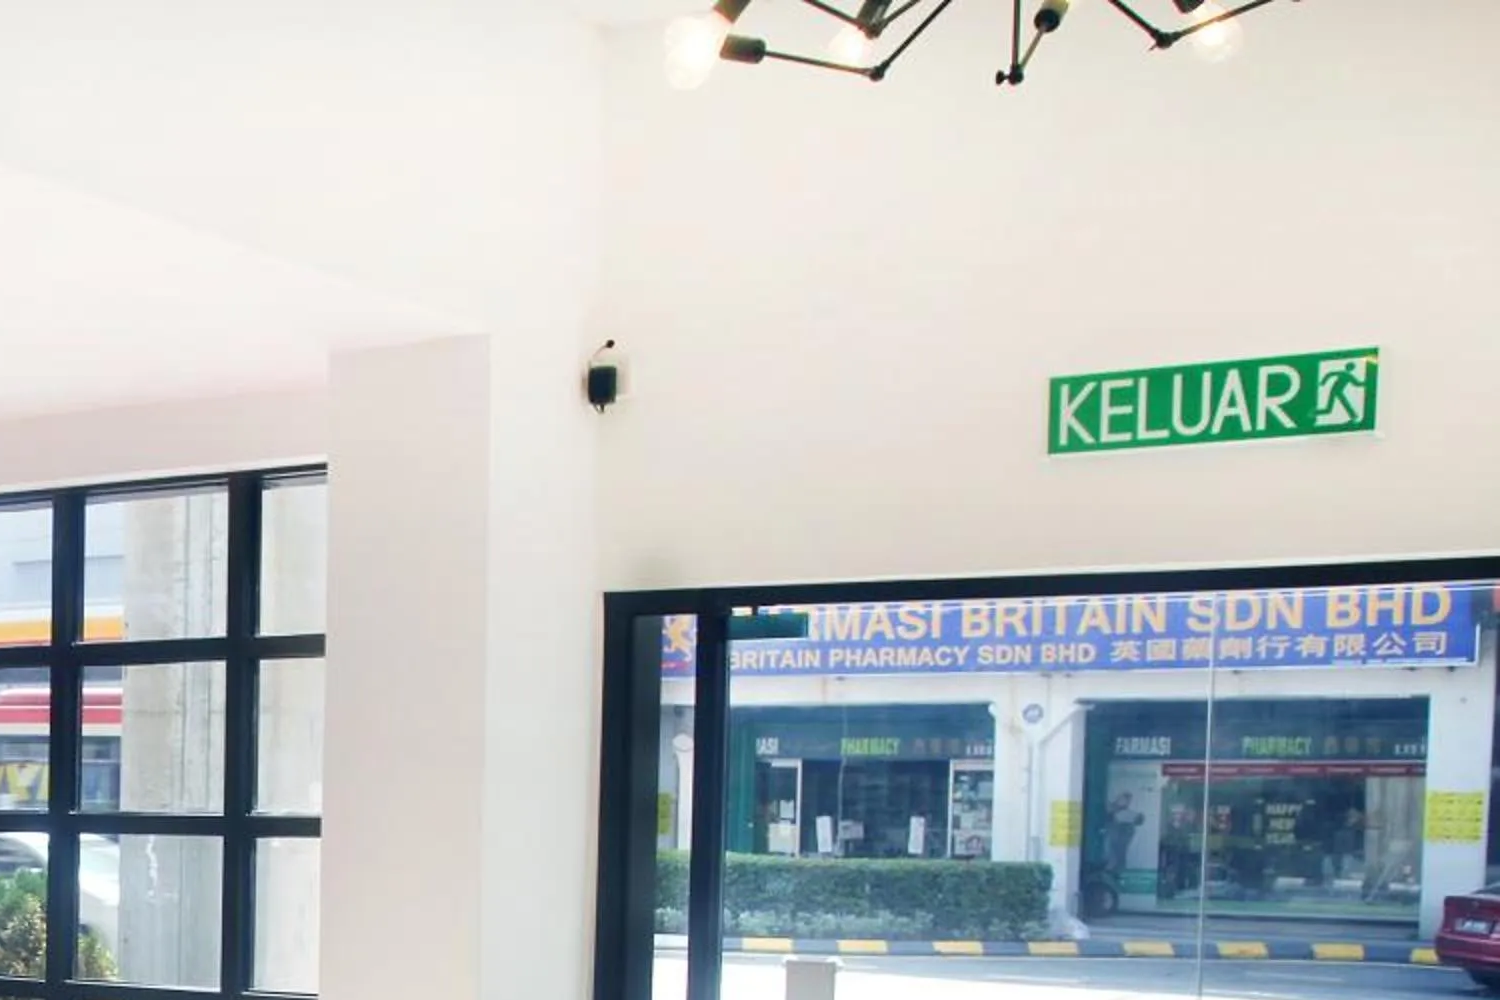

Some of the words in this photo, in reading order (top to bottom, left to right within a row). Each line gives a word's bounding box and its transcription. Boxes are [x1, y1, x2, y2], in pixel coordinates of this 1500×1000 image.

[1057, 363, 1301, 447] KELUAR
[961, 597, 1170, 638] BRITAIN
[1186, 590, 1304, 632] SDN
[1326, 584, 1452, 628] BHD
[729, 649, 821, 671] BRITAIN
[828, 645, 970, 669] PHARMACY
[977, 643, 1032, 665] SDN
[1040, 642, 1097, 664] BHD
